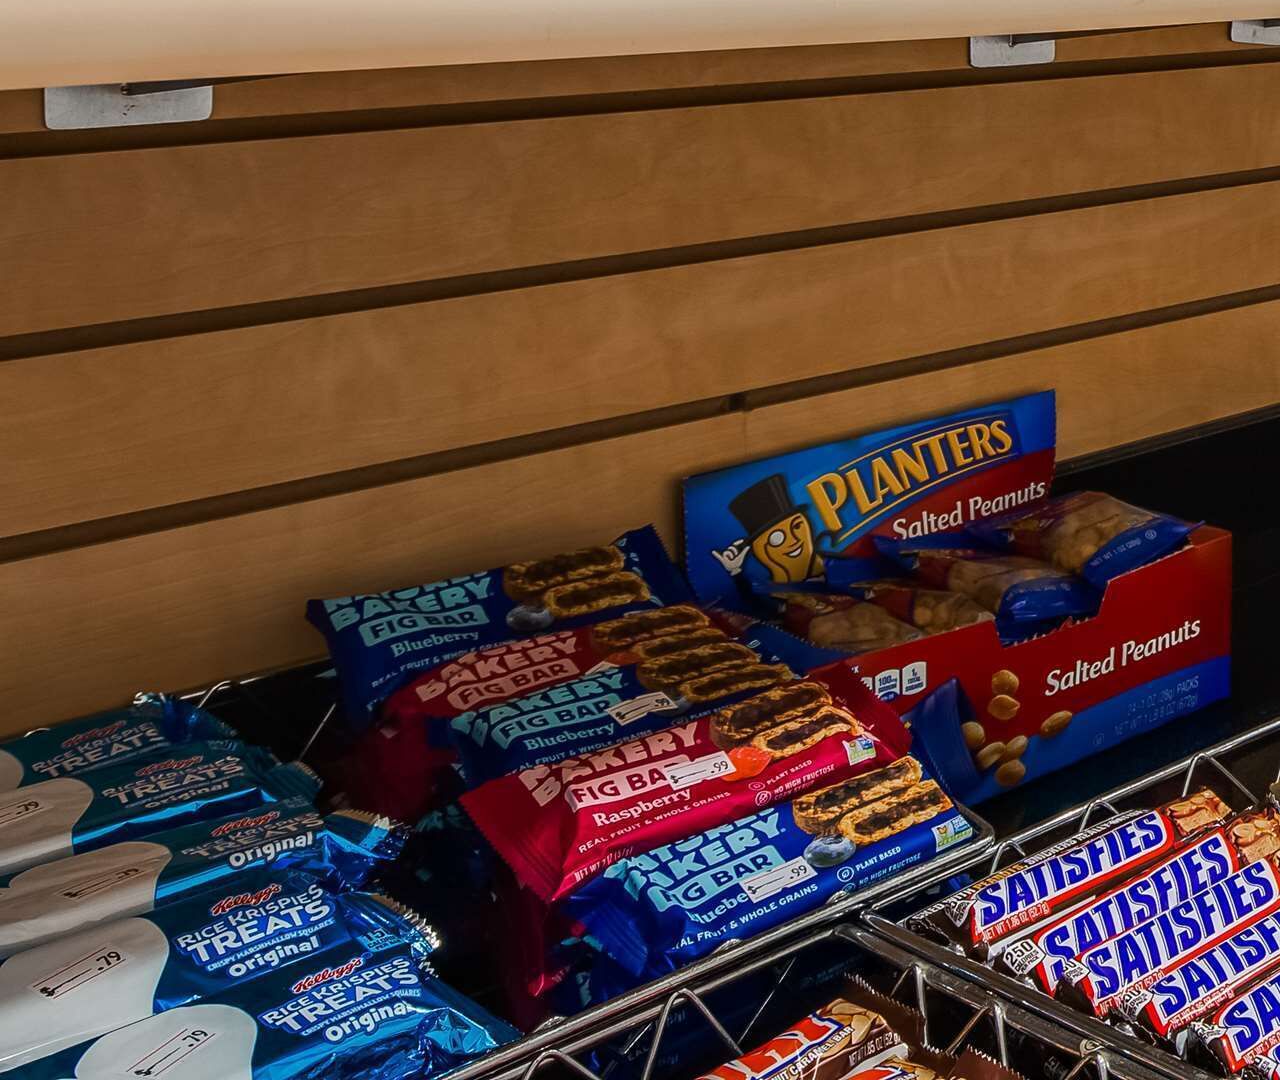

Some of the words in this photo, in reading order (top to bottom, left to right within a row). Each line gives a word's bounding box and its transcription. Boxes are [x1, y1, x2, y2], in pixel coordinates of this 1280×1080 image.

[808, 418, 1014, 533] PLANTERS
[892, 505, 963, 542] Salted
[967, 480, 1046, 522] Peanuts
[330, 576, 493, 632] BAKERY
[369, 610, 418, 645] FIG
[429, 608, 477, 628] BAR
[389, 630, 480, 658] Blueberry
[415, 636, 579, 703] BAKERY
[1044, 646, 1117, 698] Salted
[1121, 619, 1202, 670] Peanuts
[458, 680, 501, 706] FIG
[514, 662, 568, 689] BAR
[498, 716, 545, 741] FIG
[555, 697, 609, 725] BAR
[522, 724, 616, 752] Blueberry
[40, 728, 165, 778] TREATS
[531, 721, 700, 808] BAKERY
[710, 758, 730, 775] .99
[765, 769, 789, 787] PLANT
[789, 758, 813, 777] BASED
[101, 778, 147, 799] RICE
[150, 755, 241, 783] KRISPIES
[110, 763, 244, 805] TREATS
[573, 781, 621, 806] FIG
[578, 839, 608, 855] REAL
[610, 824, 643, 843] FRUIT
[654, 803, 691, 821] WHOLE
[692, 790, 732, 808] GRAINS
[592, 788, 693, 828] Raspberry
[193, 819, 326, 860] TREATS
[229, 831, 314, 867] Original
[854, 853, 880, 872] PLANT
[878, 845, 902, 863] BASED
[710, 854, 773, 887] BAR
[788, 864, 808, 882] .99
[975, 811, 1166, 927] SATISFIES
[178, 924, 226, 949] RICE
[230, 883, 324, 927] KRISPIES
[211, 883, 283, 916] Kellogg's
[739, 901, 778, 925] WHOLE
[779, 882, 819, 906] GRAINS
[1044, 837, 1231, 984] SATISFIES
[187, 899, 333, 965] TREATS
[207, 957, 236, 972] CRISPY
[236, 929, 298, 961] MARSHMALLOW
[297, 919, 335, 937] SQUARES
[1090, 859, 1277, 1000] SATISFIES
[97, 949, 122, 973] .79
[228, 935, 321, 978] Original
[291, 956, 364, 995] Kellogg's
[1006, 942, 1034, 967] 250
[263, 1002, 311, 1026] RICE
[315, 957, 412, 1005] KRISPIES
[276, 969, 420, 1035] TREATS
[302, 1021, 331, 1036] CRISPY
[331, 996, 391, 1025] MARSHMALLOW
[324, 1003, 414, 1045] Original
[181, 1028, 209, 1049] .79
[788, 1046, 833, 1075] CARAMEL
[832, 1024, 856, 1047] BAR
